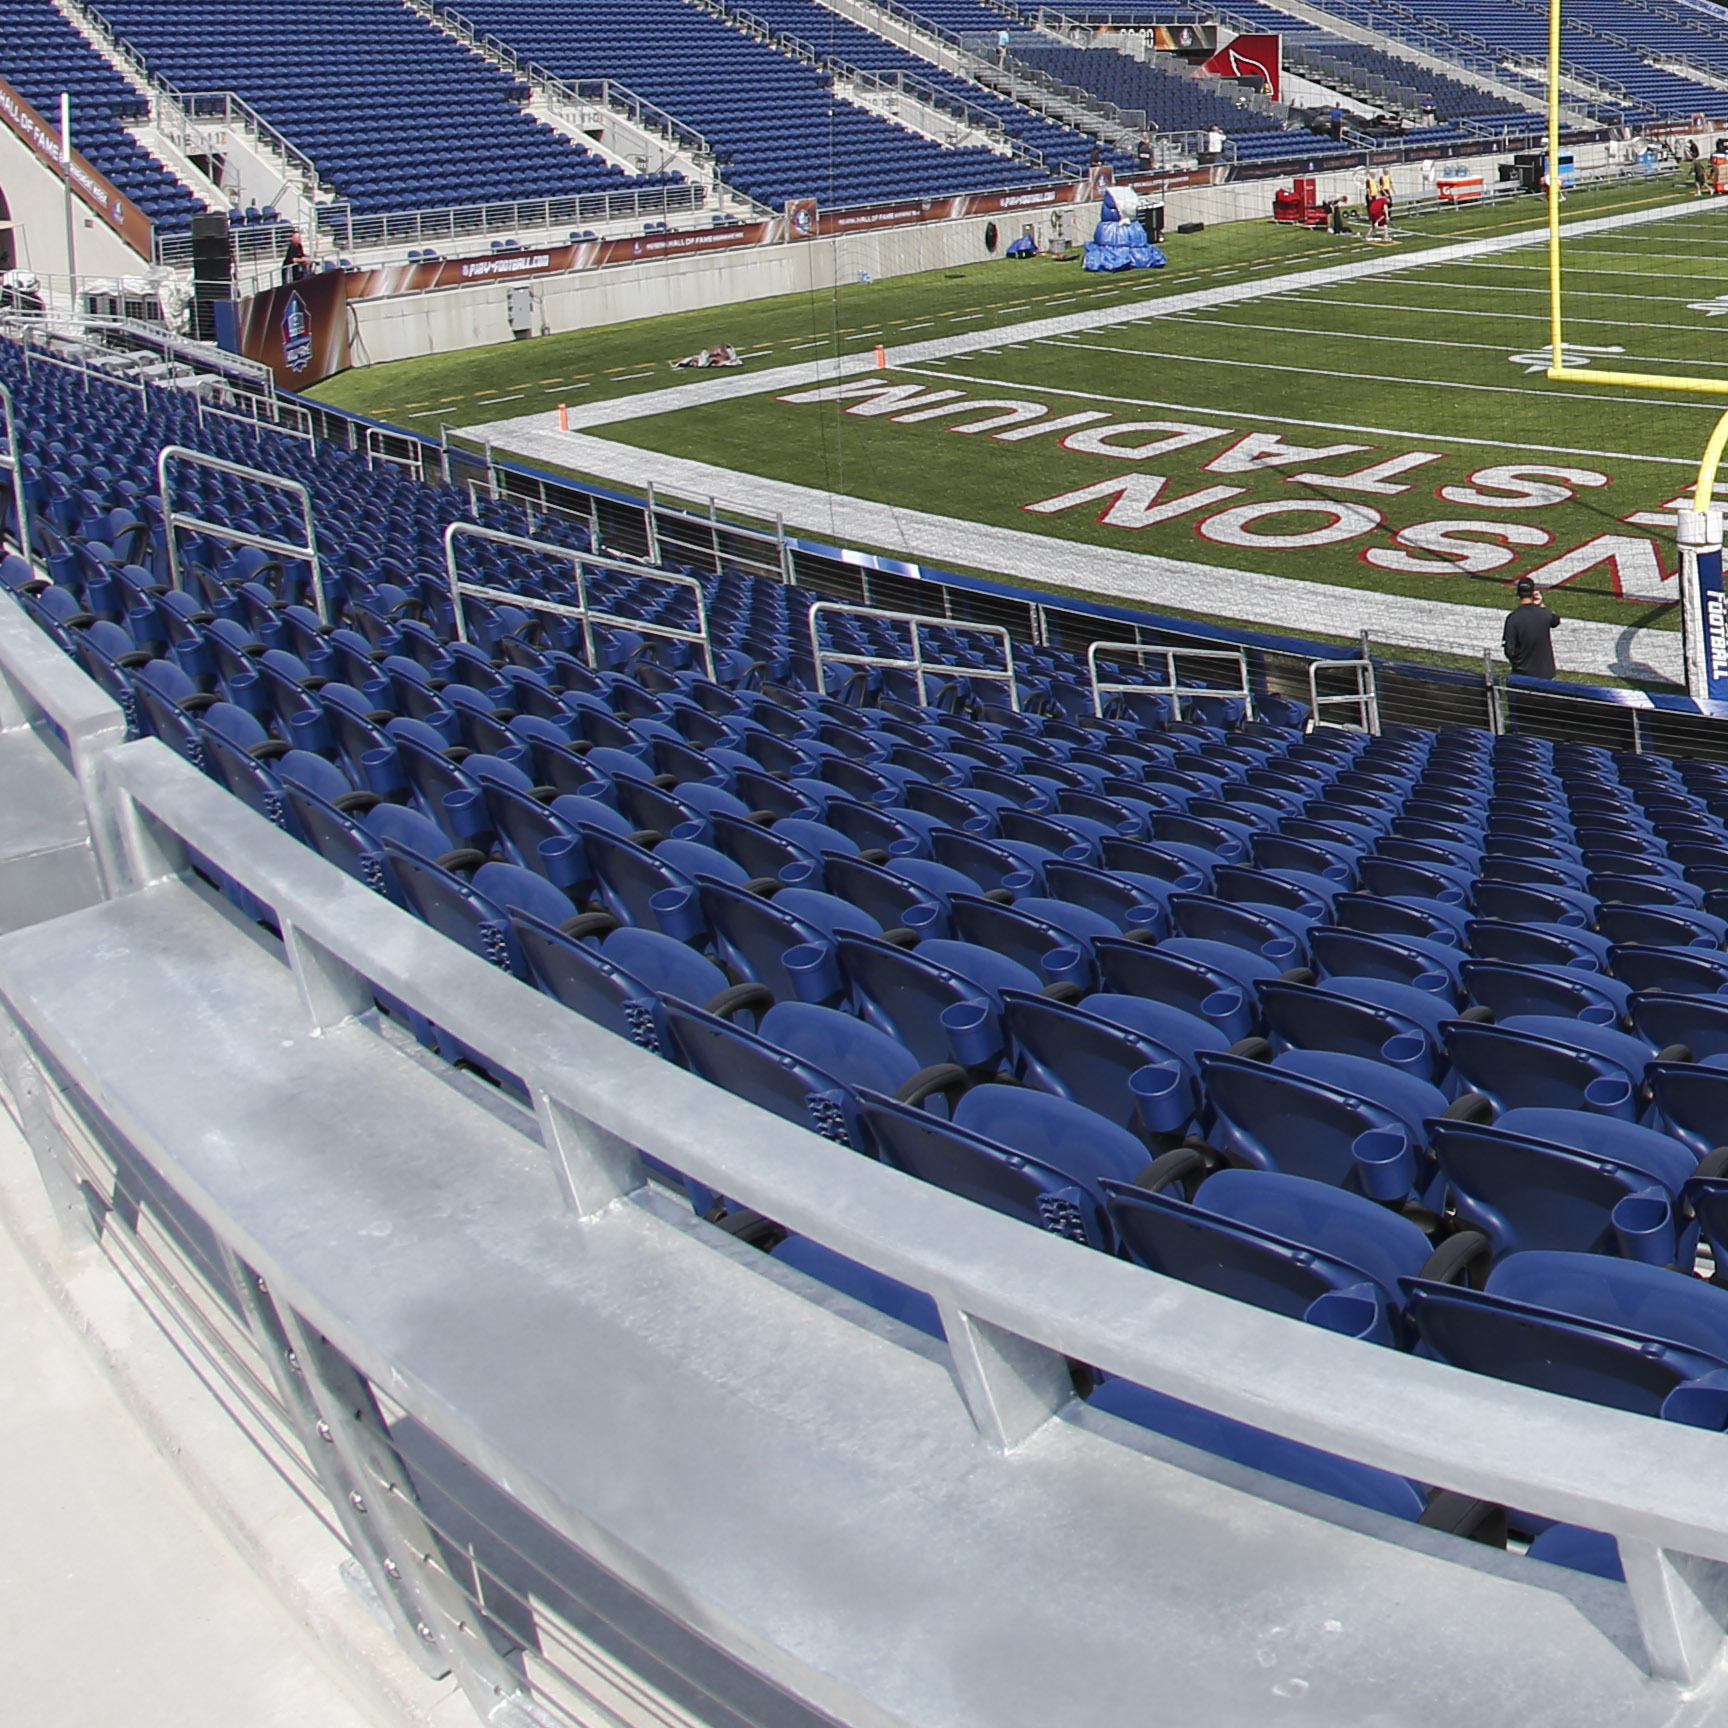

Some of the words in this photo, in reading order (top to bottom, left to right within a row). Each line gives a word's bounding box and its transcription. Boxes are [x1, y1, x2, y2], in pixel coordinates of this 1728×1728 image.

[20, 111, 34, 133] OF
[32, 124, 60, 163] FAME
[774, 376, 1612, 510] STADIUM
